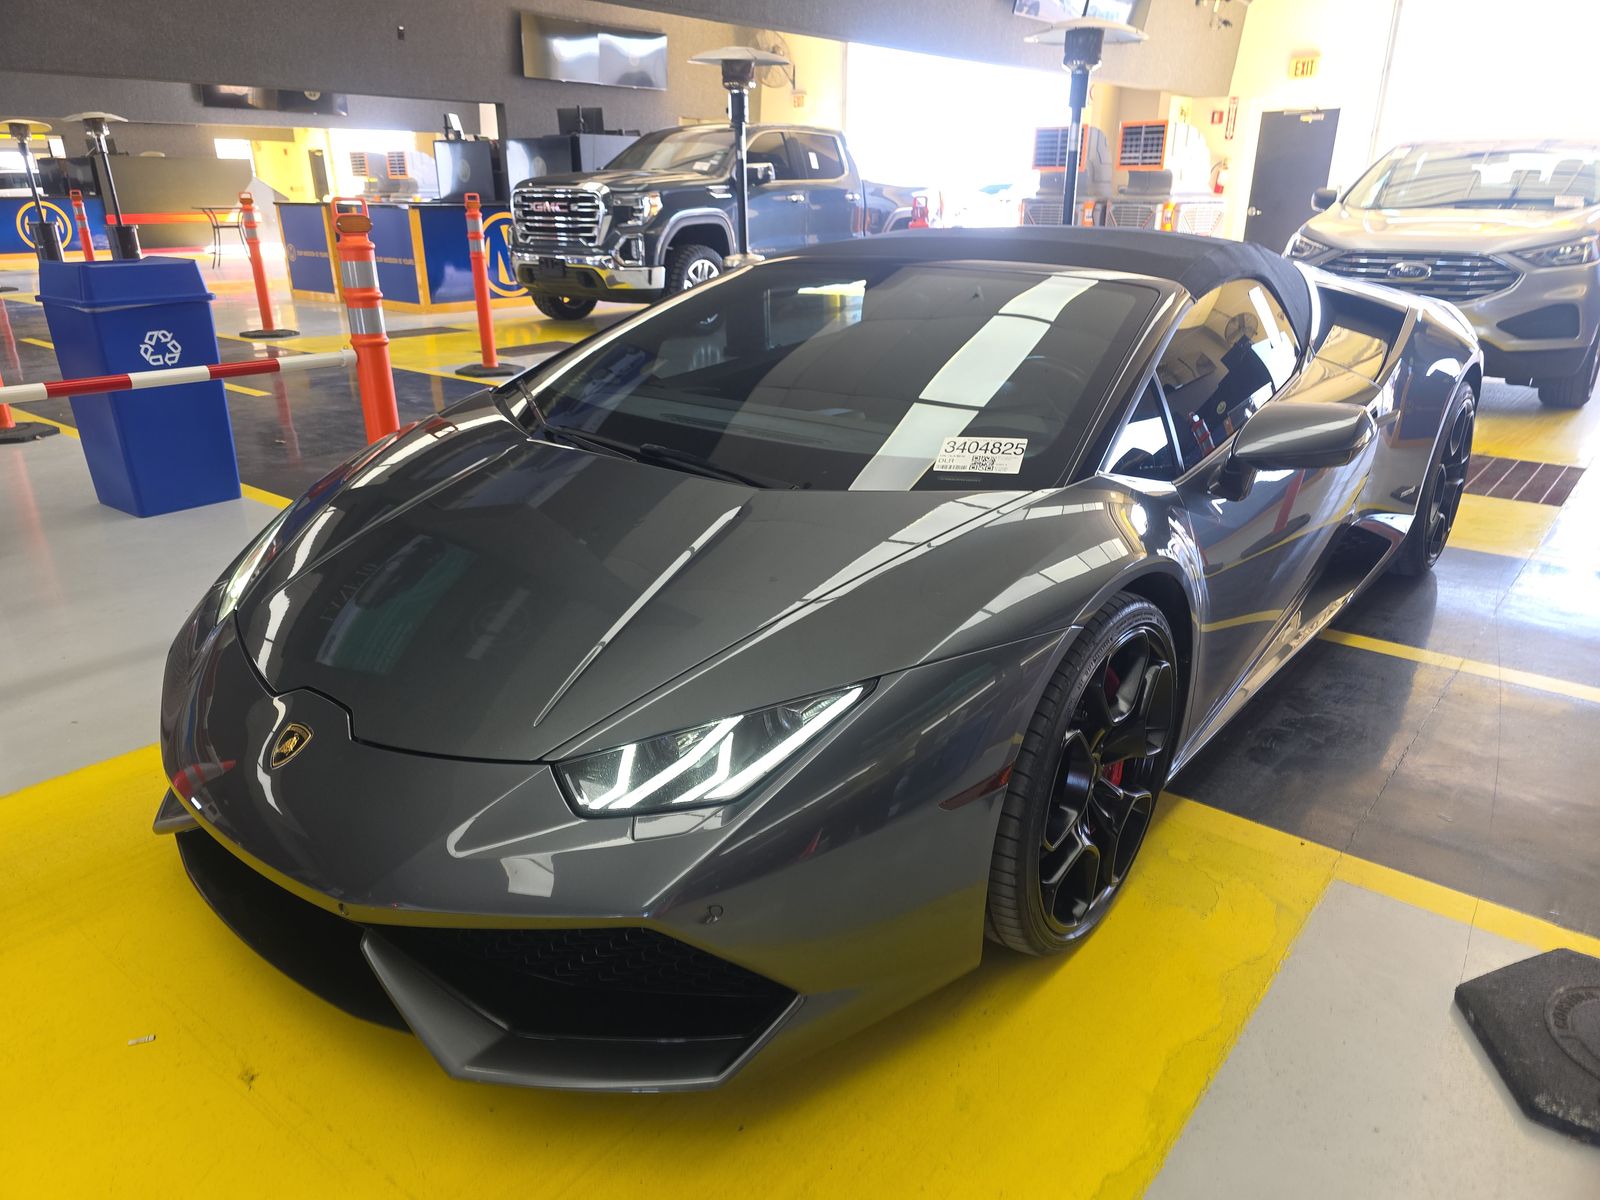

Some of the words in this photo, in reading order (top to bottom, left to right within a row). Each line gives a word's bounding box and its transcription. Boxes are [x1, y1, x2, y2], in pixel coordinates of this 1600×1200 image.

[1294, 60, 1314, 77] EXIT
[533, 202, 568, 212] GMC
[944, 441, 1026, 456] 3404825
